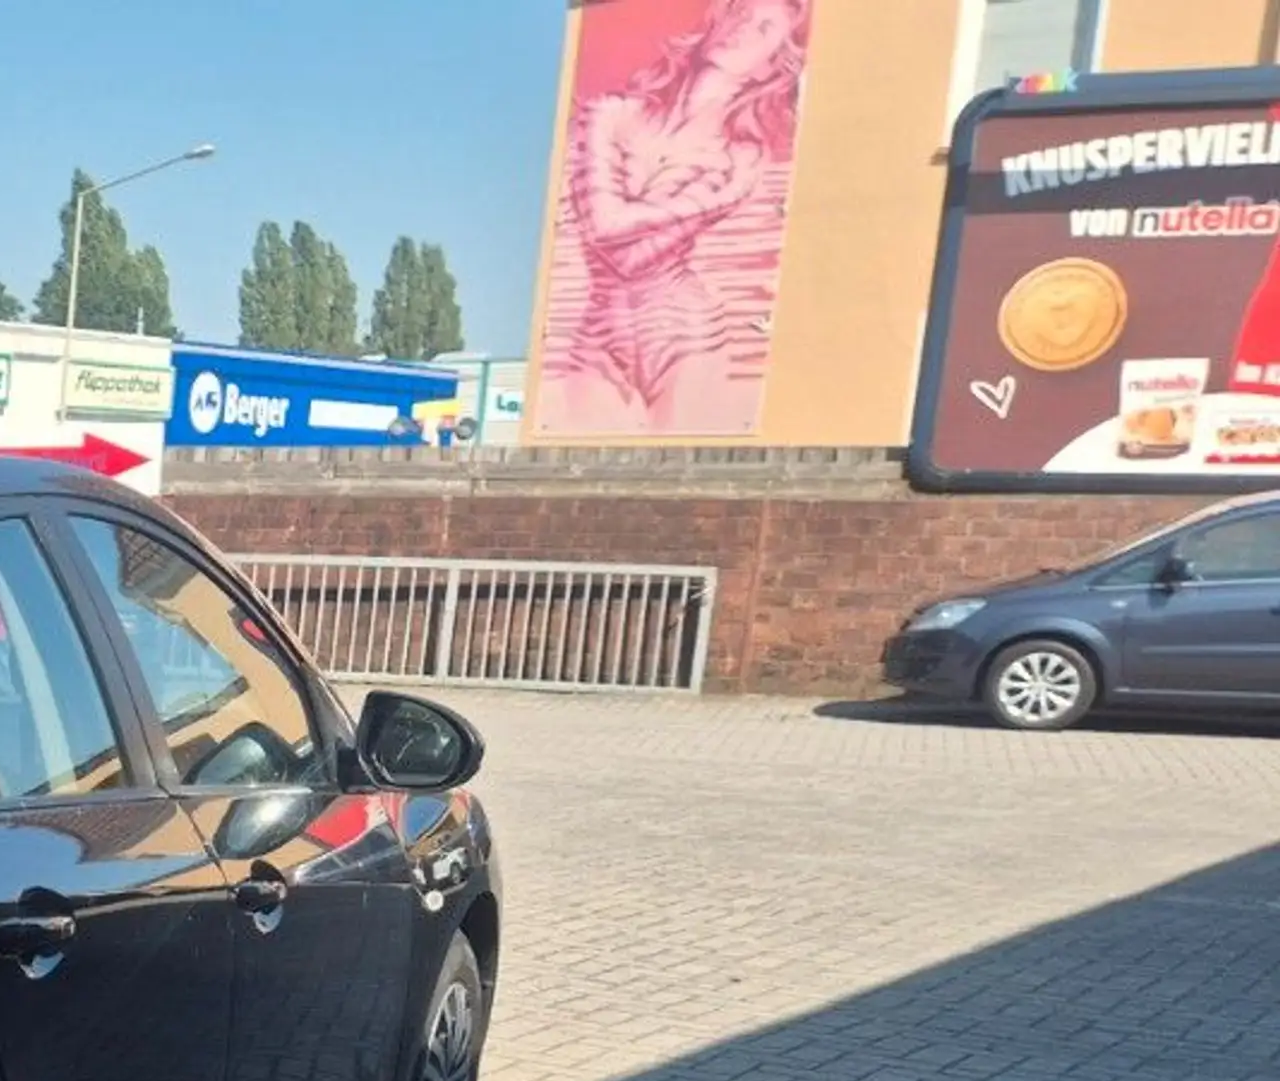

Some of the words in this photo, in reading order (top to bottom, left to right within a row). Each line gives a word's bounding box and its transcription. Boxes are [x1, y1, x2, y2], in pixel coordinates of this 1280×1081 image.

[1002, 121, 1280, 198] KNUSPERVIEL
[1069, 208, 1129, 237] von
[1137, 200, 1276, 235] nutella
[224, 382, 289, 438] Berger
